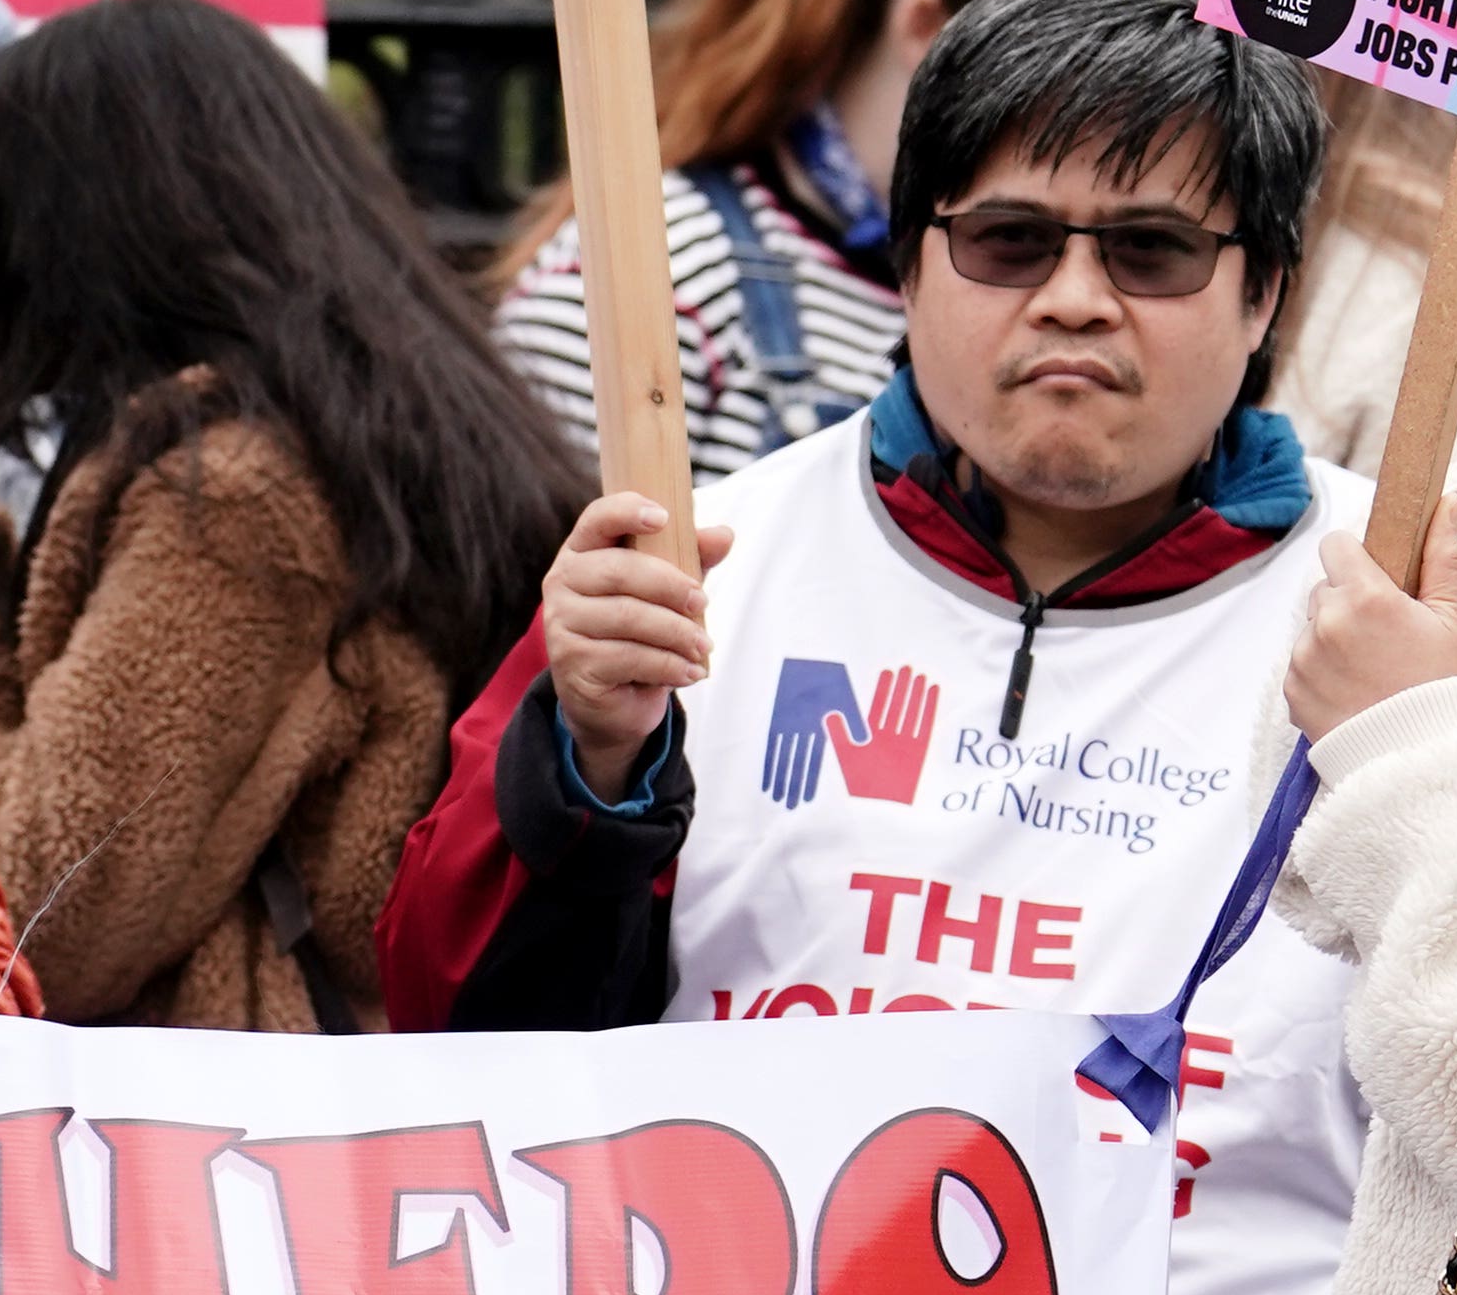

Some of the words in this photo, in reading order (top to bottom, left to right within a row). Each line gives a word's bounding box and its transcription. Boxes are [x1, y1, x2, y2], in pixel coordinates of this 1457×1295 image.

[1355, 18, 1435, 78] JOBS
[954, 727, 1072, 772] Royal
[1077, 738, 1230, 809] College
[943, 781, 988, 812] of
[998, 781, 1156, 854] Nursing
[849, 872, 1083, 981] THE
